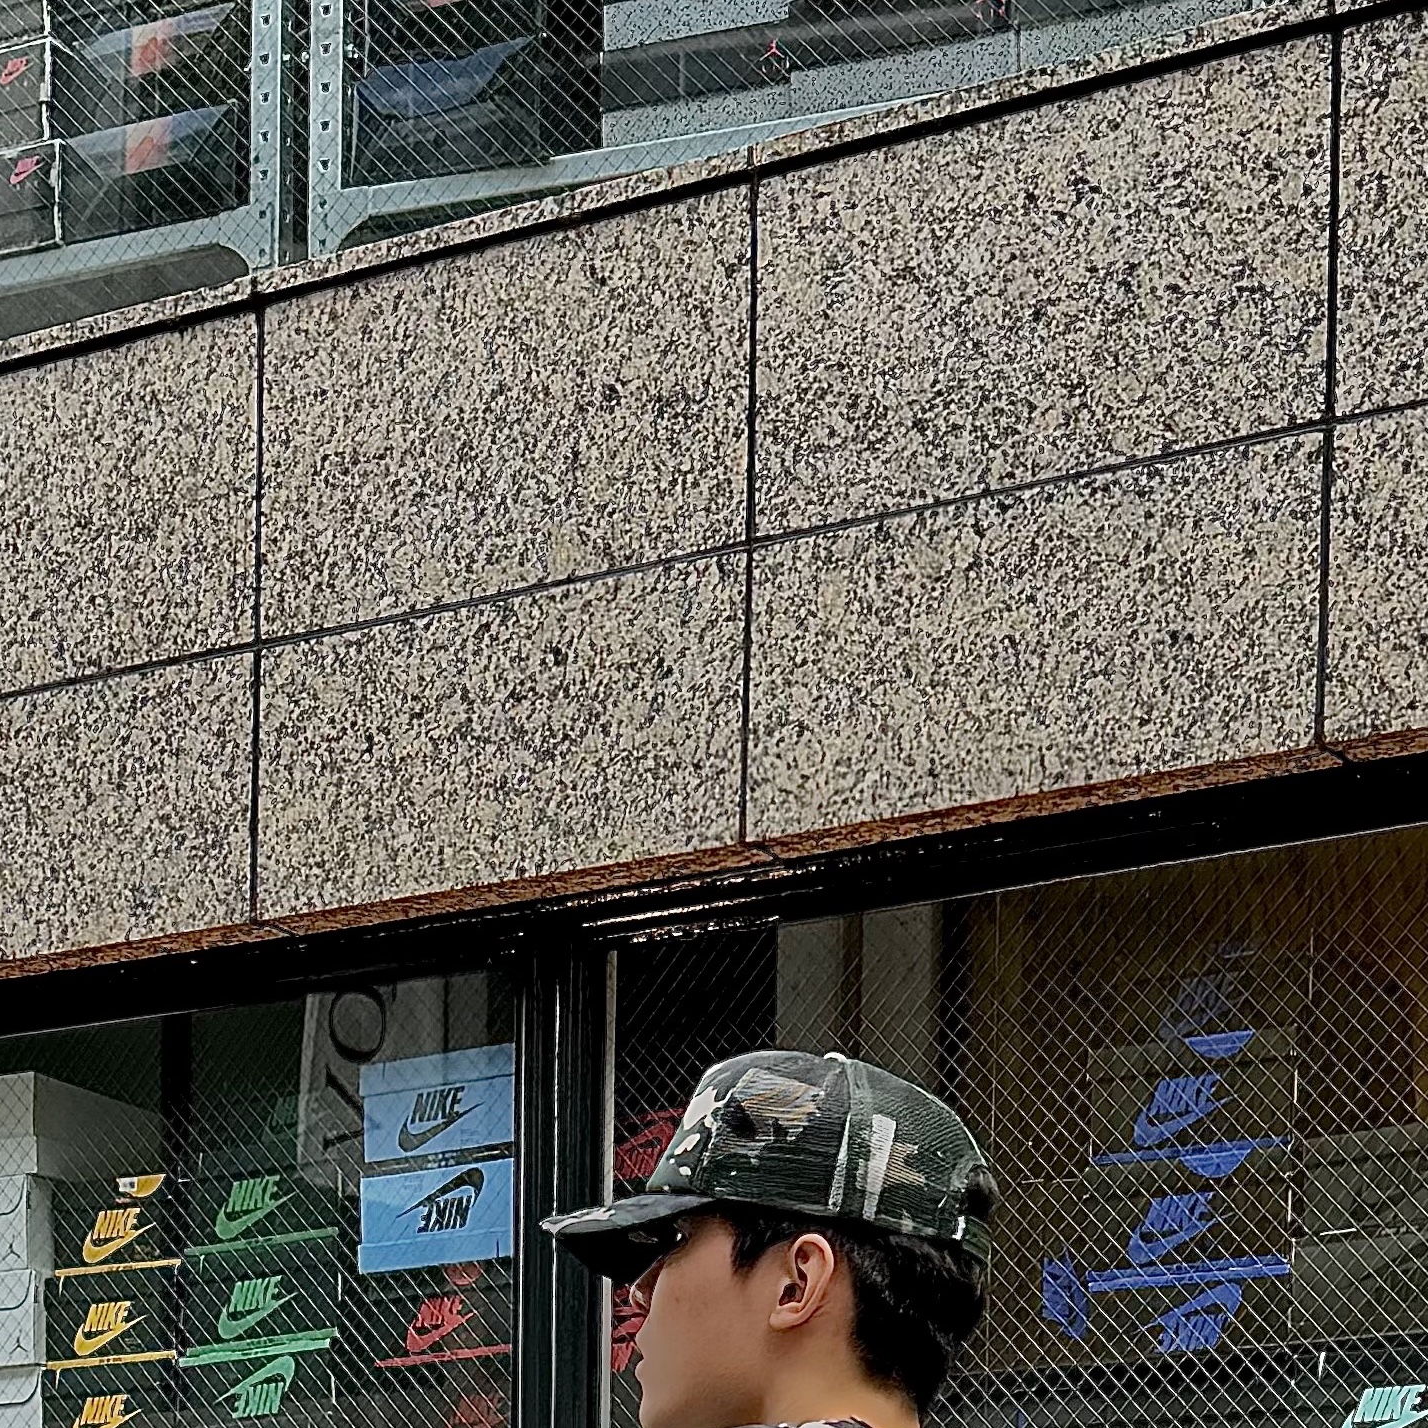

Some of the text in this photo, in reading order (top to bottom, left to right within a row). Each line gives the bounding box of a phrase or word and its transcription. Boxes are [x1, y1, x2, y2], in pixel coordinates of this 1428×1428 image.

[410, 1086, 465, 1125] NIKE
[1148, 1072, 1220, 1115] NIKE
[227, 1175, 280, 1212] NIKE
[1141, 1191, 1216, 1232] NIKE
[93, 1208, 140, 1239] NIKE
[417, 1195, 472, 1233] NIKE
[229, 1275, 283, 1312] NIKE
[84, 1301, 131, 1332] NIKE
[81, 1394, 129, 1424] NIKE
[232, 1382, 285, 1419] NIKE
[1353, 1384, 1426, 1422] NIKE
